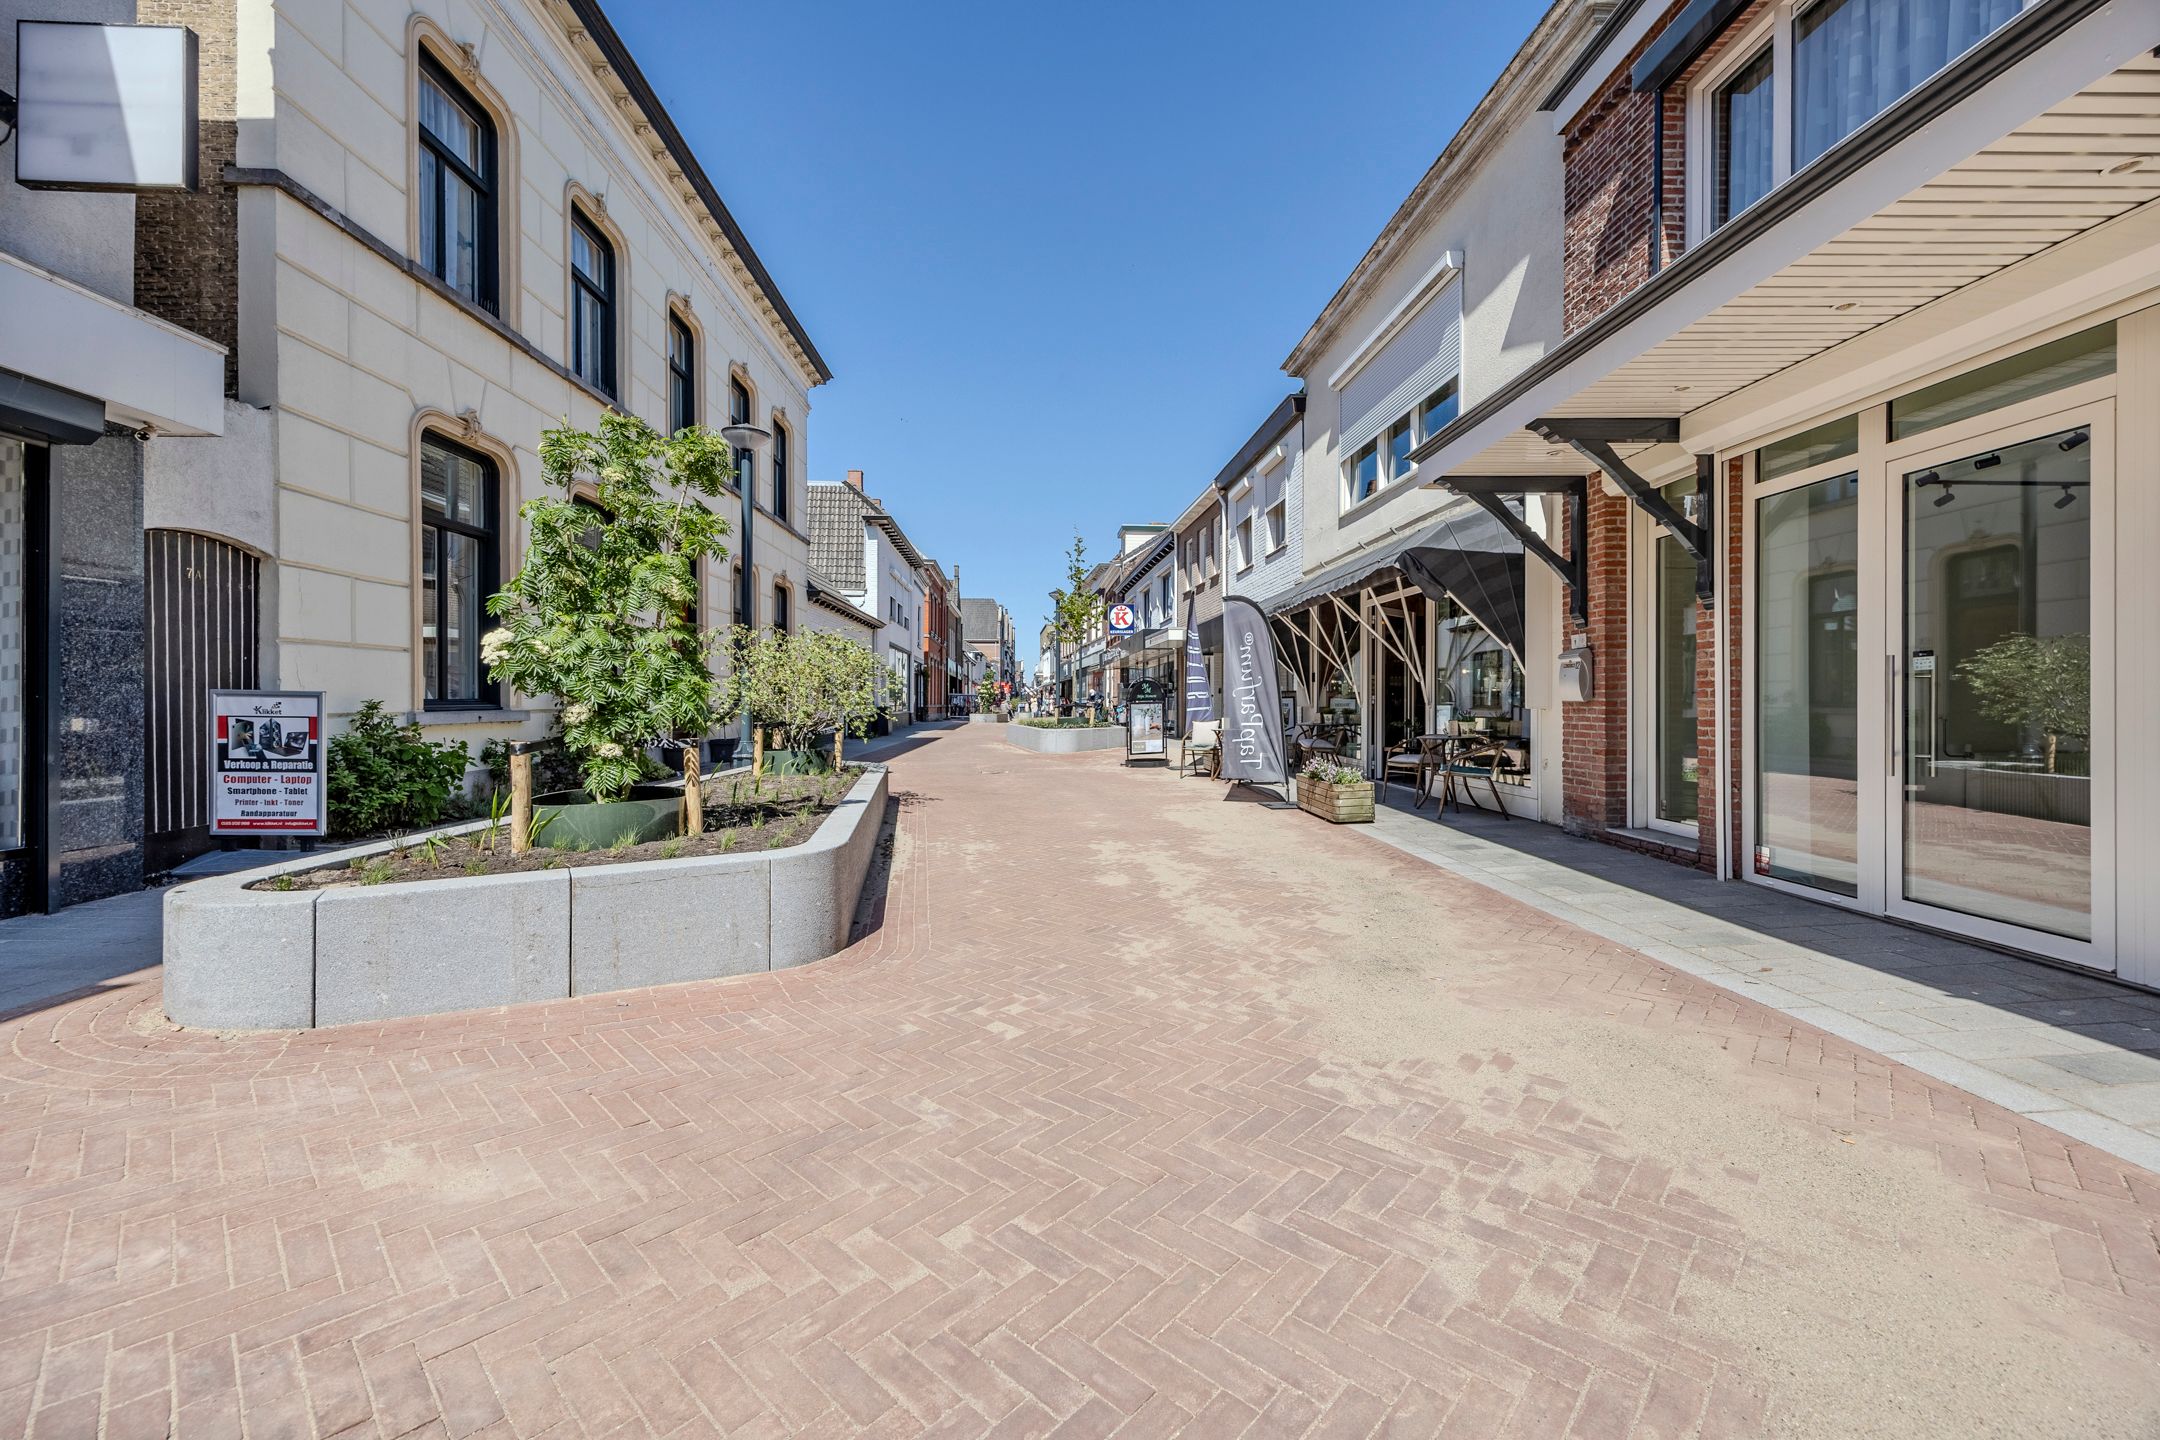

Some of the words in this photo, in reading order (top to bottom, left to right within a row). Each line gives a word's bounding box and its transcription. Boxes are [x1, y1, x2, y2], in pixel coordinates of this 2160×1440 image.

[1114, 611, 1129, 625] K
[253, 705, 282, 715] Klikket
[223, 760, 261, 770] Verkoop
[262, 761, 270, 770] &
[270, 760, 314, 770] Reparatie
[223, 774, 272, 784] Computer
[280, 775, 312, 784] Laptop
[227, 787, 277, 795] Smartphone
[284, 787, 308, 795] Tablet
[240, 810, 298, 818] Randapparatuur
